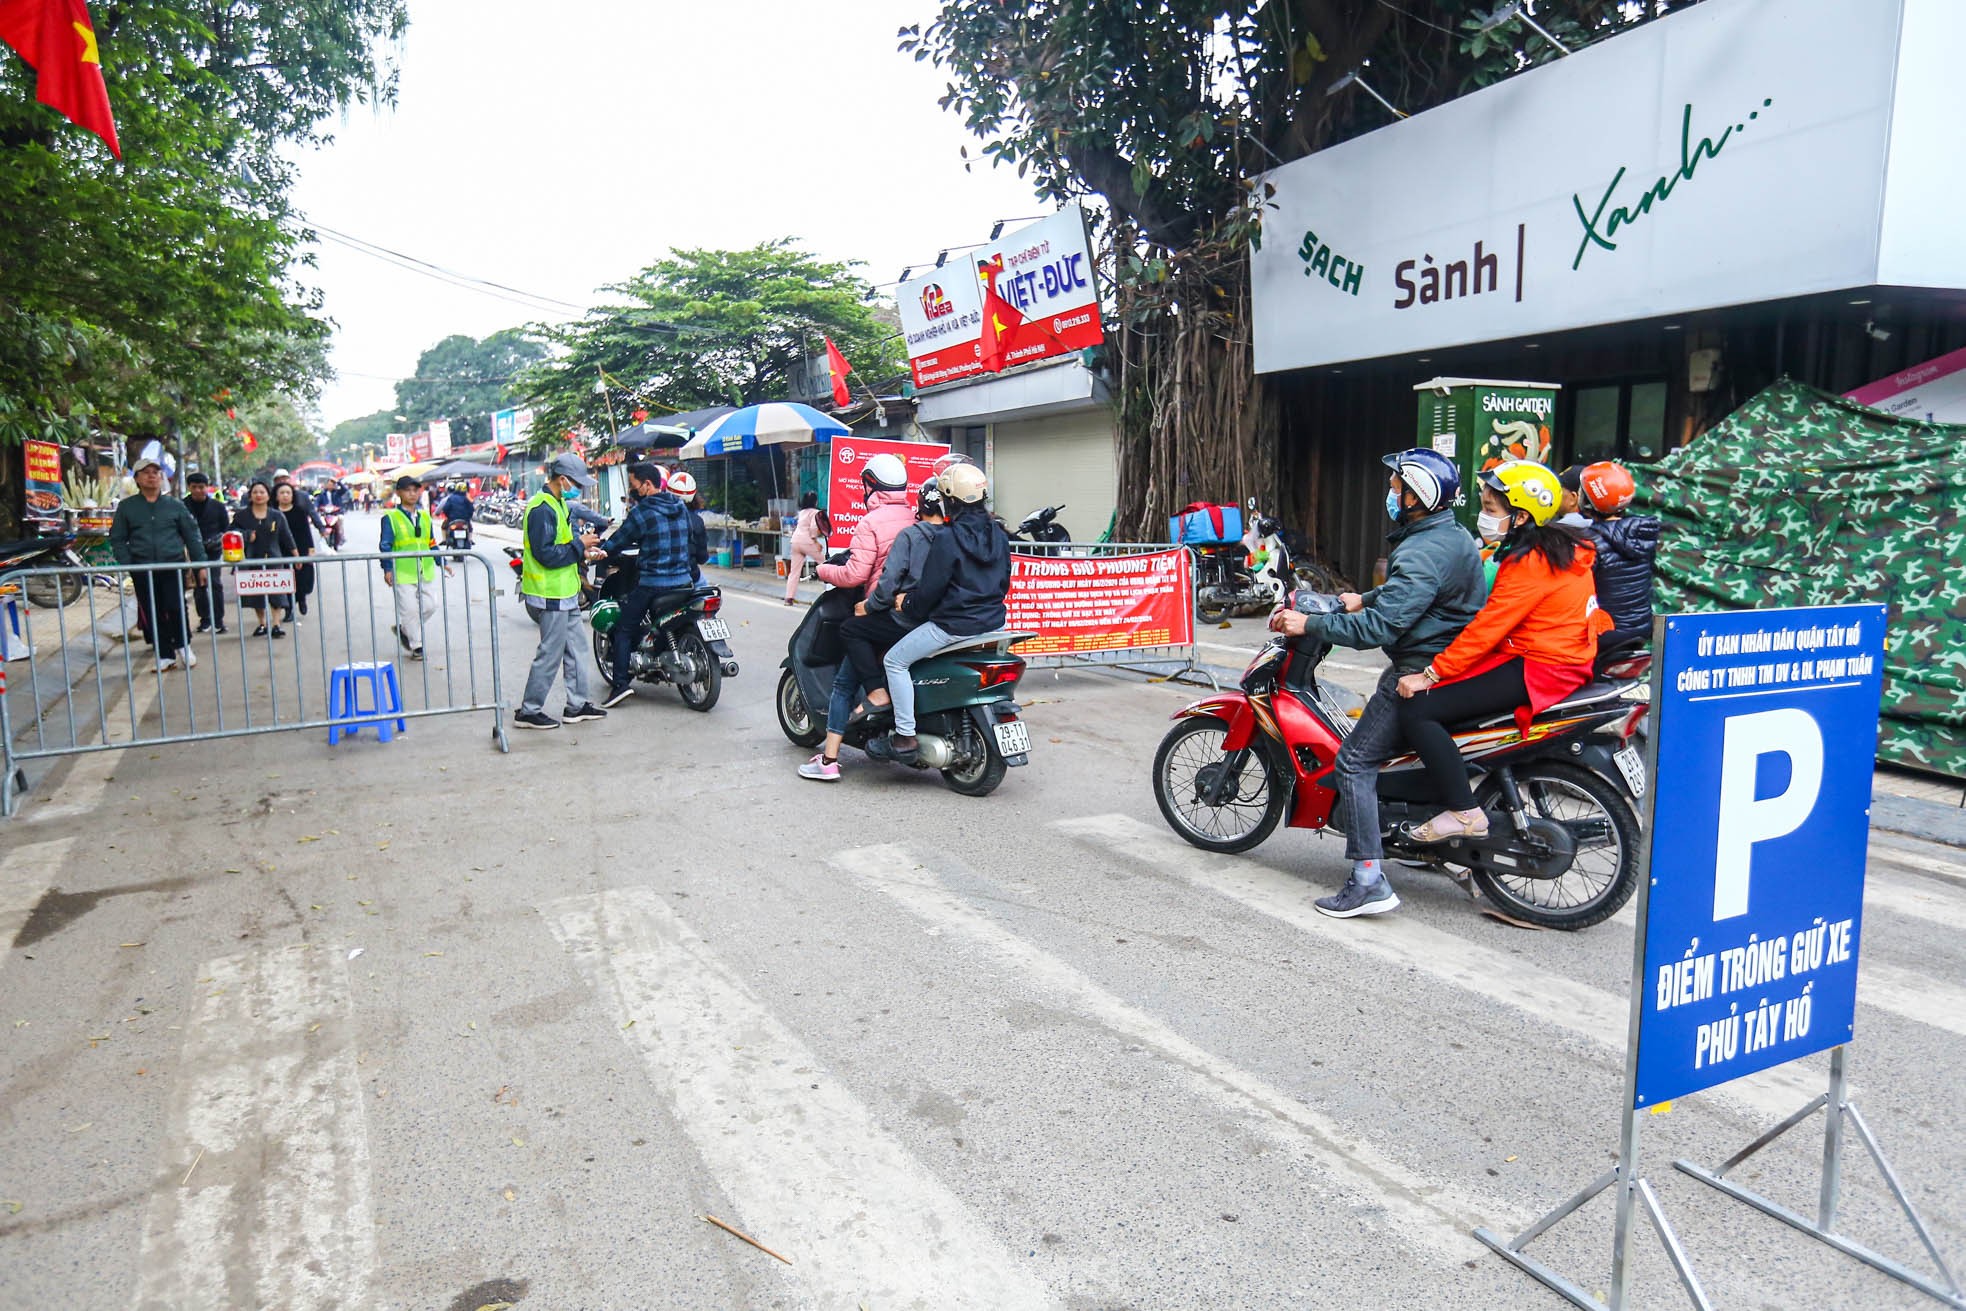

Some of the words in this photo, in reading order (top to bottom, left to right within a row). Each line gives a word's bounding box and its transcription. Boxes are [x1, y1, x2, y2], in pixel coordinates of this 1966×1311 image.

[1298, 230, 1364, 296] SẠCH
[1394, 240, 1498, 309] Sành
[240, 579, 270, 589] DỪNG
[1677, 667, 1710, 692] CÔNG
[1712, 669, 1727, 689] TY
[1727, 666, 1756, 687] TNHH
[1758, 664, 1774, 684] TM
[1775, 663, 1790, 683] DV
[1791, 662, 1799, 681] &
[1801, 661, 1814, 680] DL
[1816, 658, 1846, 682] PHẠM
[1847, 652, 1874, 676] TUẤN
[1698, 630, 1714, 656] ỦY
[1715, 635, 1739, 656] BAN
[1741, 629, 1771, 653] NHÂN
[1773, 627, 1795, 651] DÂN
[1796, 625, 1825, 653] QUẬN
[1826, 624, 1846, 647] TÂY
[1845, 621, 1861, 646] HỒ
[1713, 707, 1824, 922] P
[1656, 937, 1715, 1011] ĐIỂM
[1720, 933, 1787, 994] TRÔNG
[1790, 917, 1828, 976] GIỮ
[1826, 919, 1853, 965] XE
[1695, 1002, 1740, 1070] PHỦ
[1744, 998, 1783, 1054] TÂY
[1784, 981, 1814, 1041] HỒ
